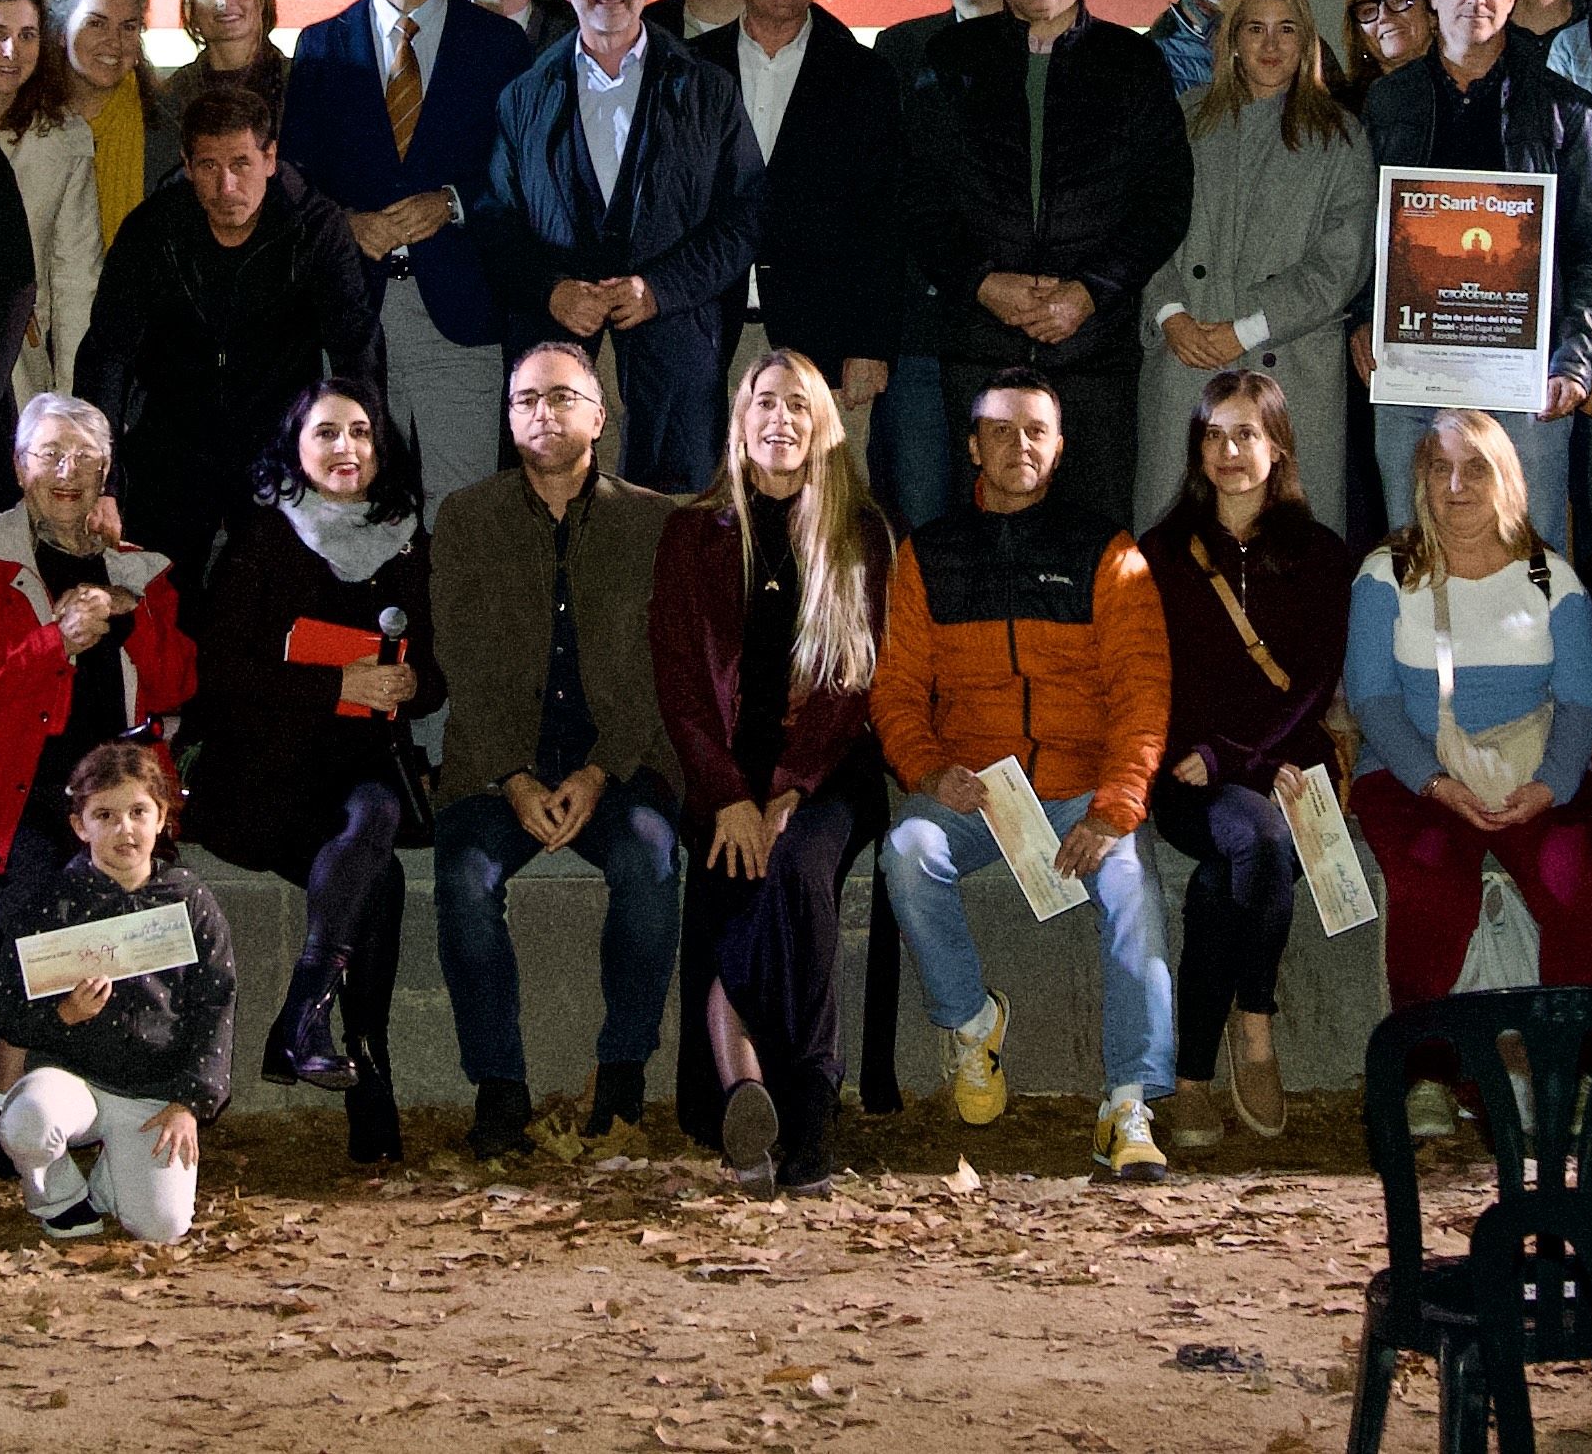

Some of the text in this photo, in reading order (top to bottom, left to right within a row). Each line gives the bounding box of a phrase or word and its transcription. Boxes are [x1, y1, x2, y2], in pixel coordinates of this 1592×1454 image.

[1400, 192, 1535, 217] TOT Sant Cugat
[1398, 305, 1427, 331] 1r
